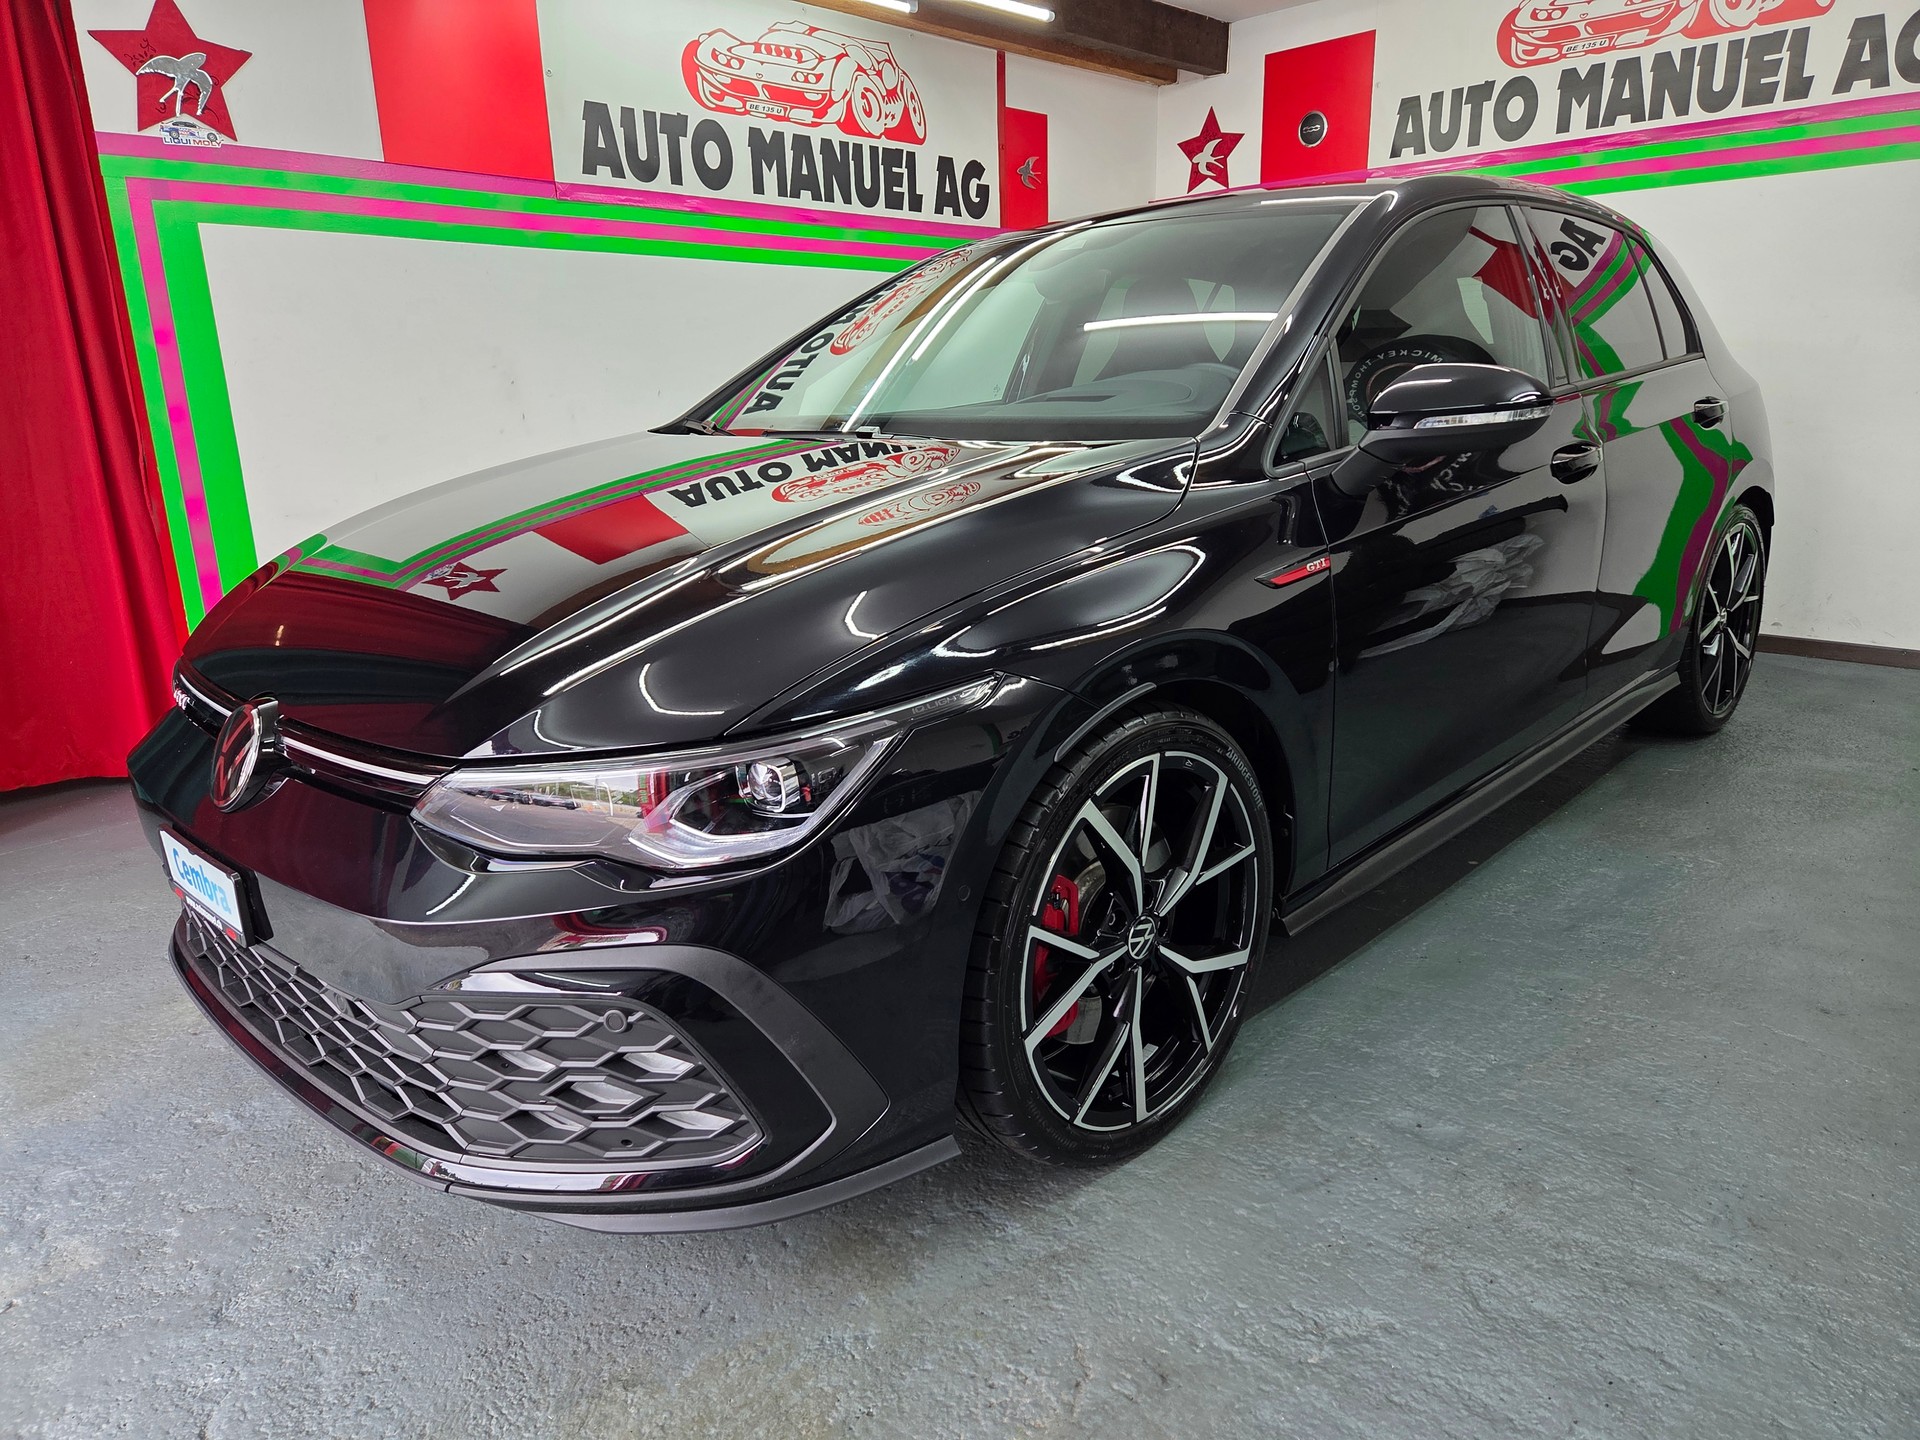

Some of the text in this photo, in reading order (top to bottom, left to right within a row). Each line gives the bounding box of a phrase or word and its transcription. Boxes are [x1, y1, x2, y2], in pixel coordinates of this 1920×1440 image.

[1581, 42, 1596, 50] 135
[1389, 75, 1538, 159] AUTO
[1555, 26, 1815, 135] MANUEL
[749, 103, 760, 111] BE
[762, 105, 775, 113] 135
[163, 137, 221, 147] LIQUI MOLY
[581, 100, 990, 220] AUTO MANUEL AG
[1306, 557, 1327, 572] GTI
[172, 847, 232, 914] Cembra
